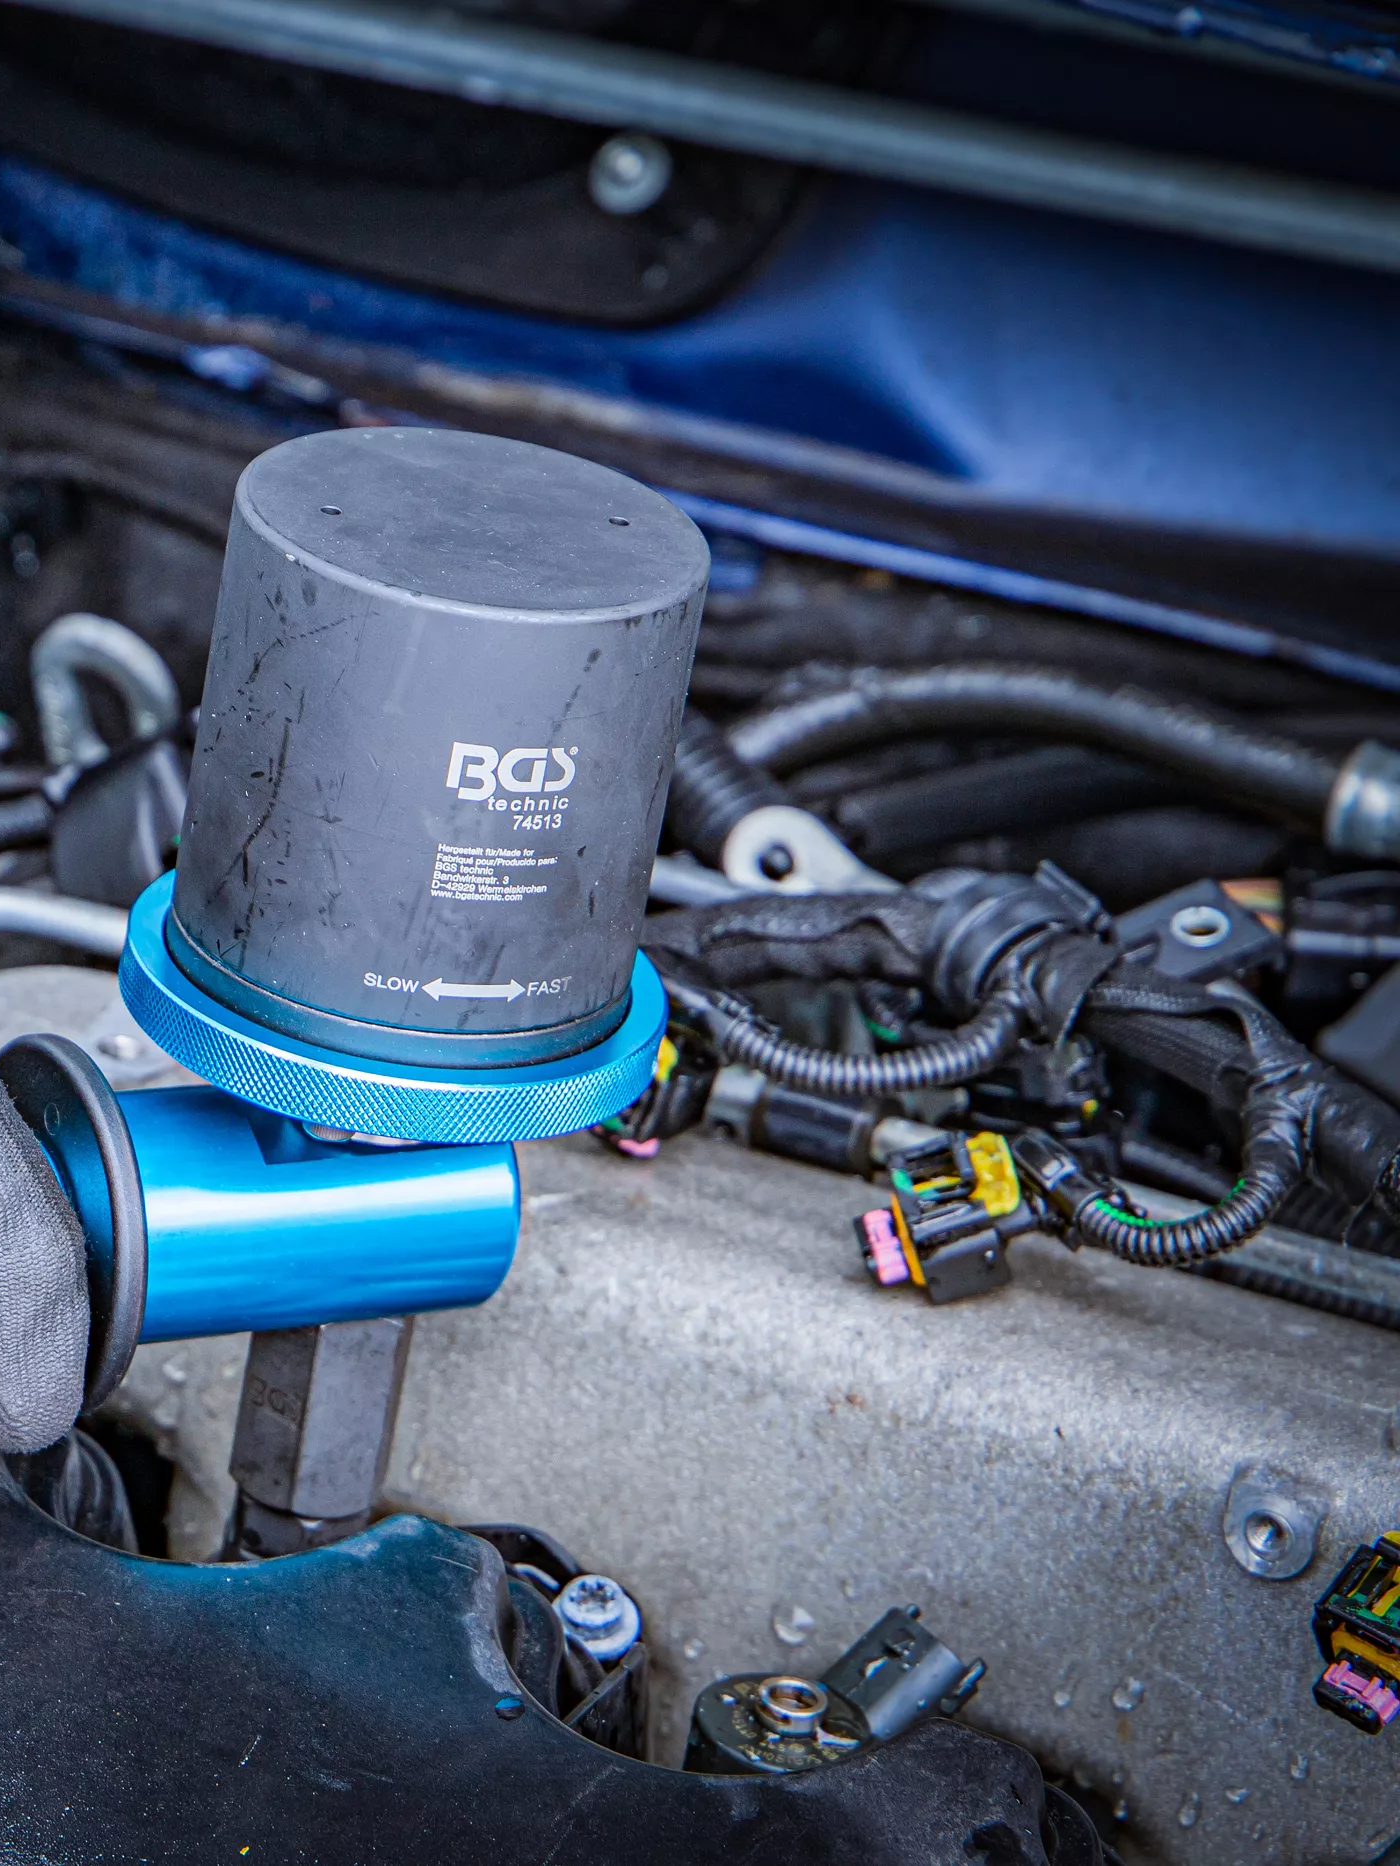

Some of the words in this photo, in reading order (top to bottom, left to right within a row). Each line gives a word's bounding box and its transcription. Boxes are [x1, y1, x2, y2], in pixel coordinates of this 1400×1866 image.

[487, 795, 569, 811] technic
[513, 813, 562, 830] 74513
[438, 843, 483, 856] Hergestellt
[523, 848, 535, 857] for
[435, 861, 457, 872] BGS
[459, 864, 494, 875] technic
[502, 876, 510, 884] 3
[431, 889, 523, 902] www.bgstechnic.com
[363, 972, 419, 993] SLOW
[526, 976, 573, 997] FAST
